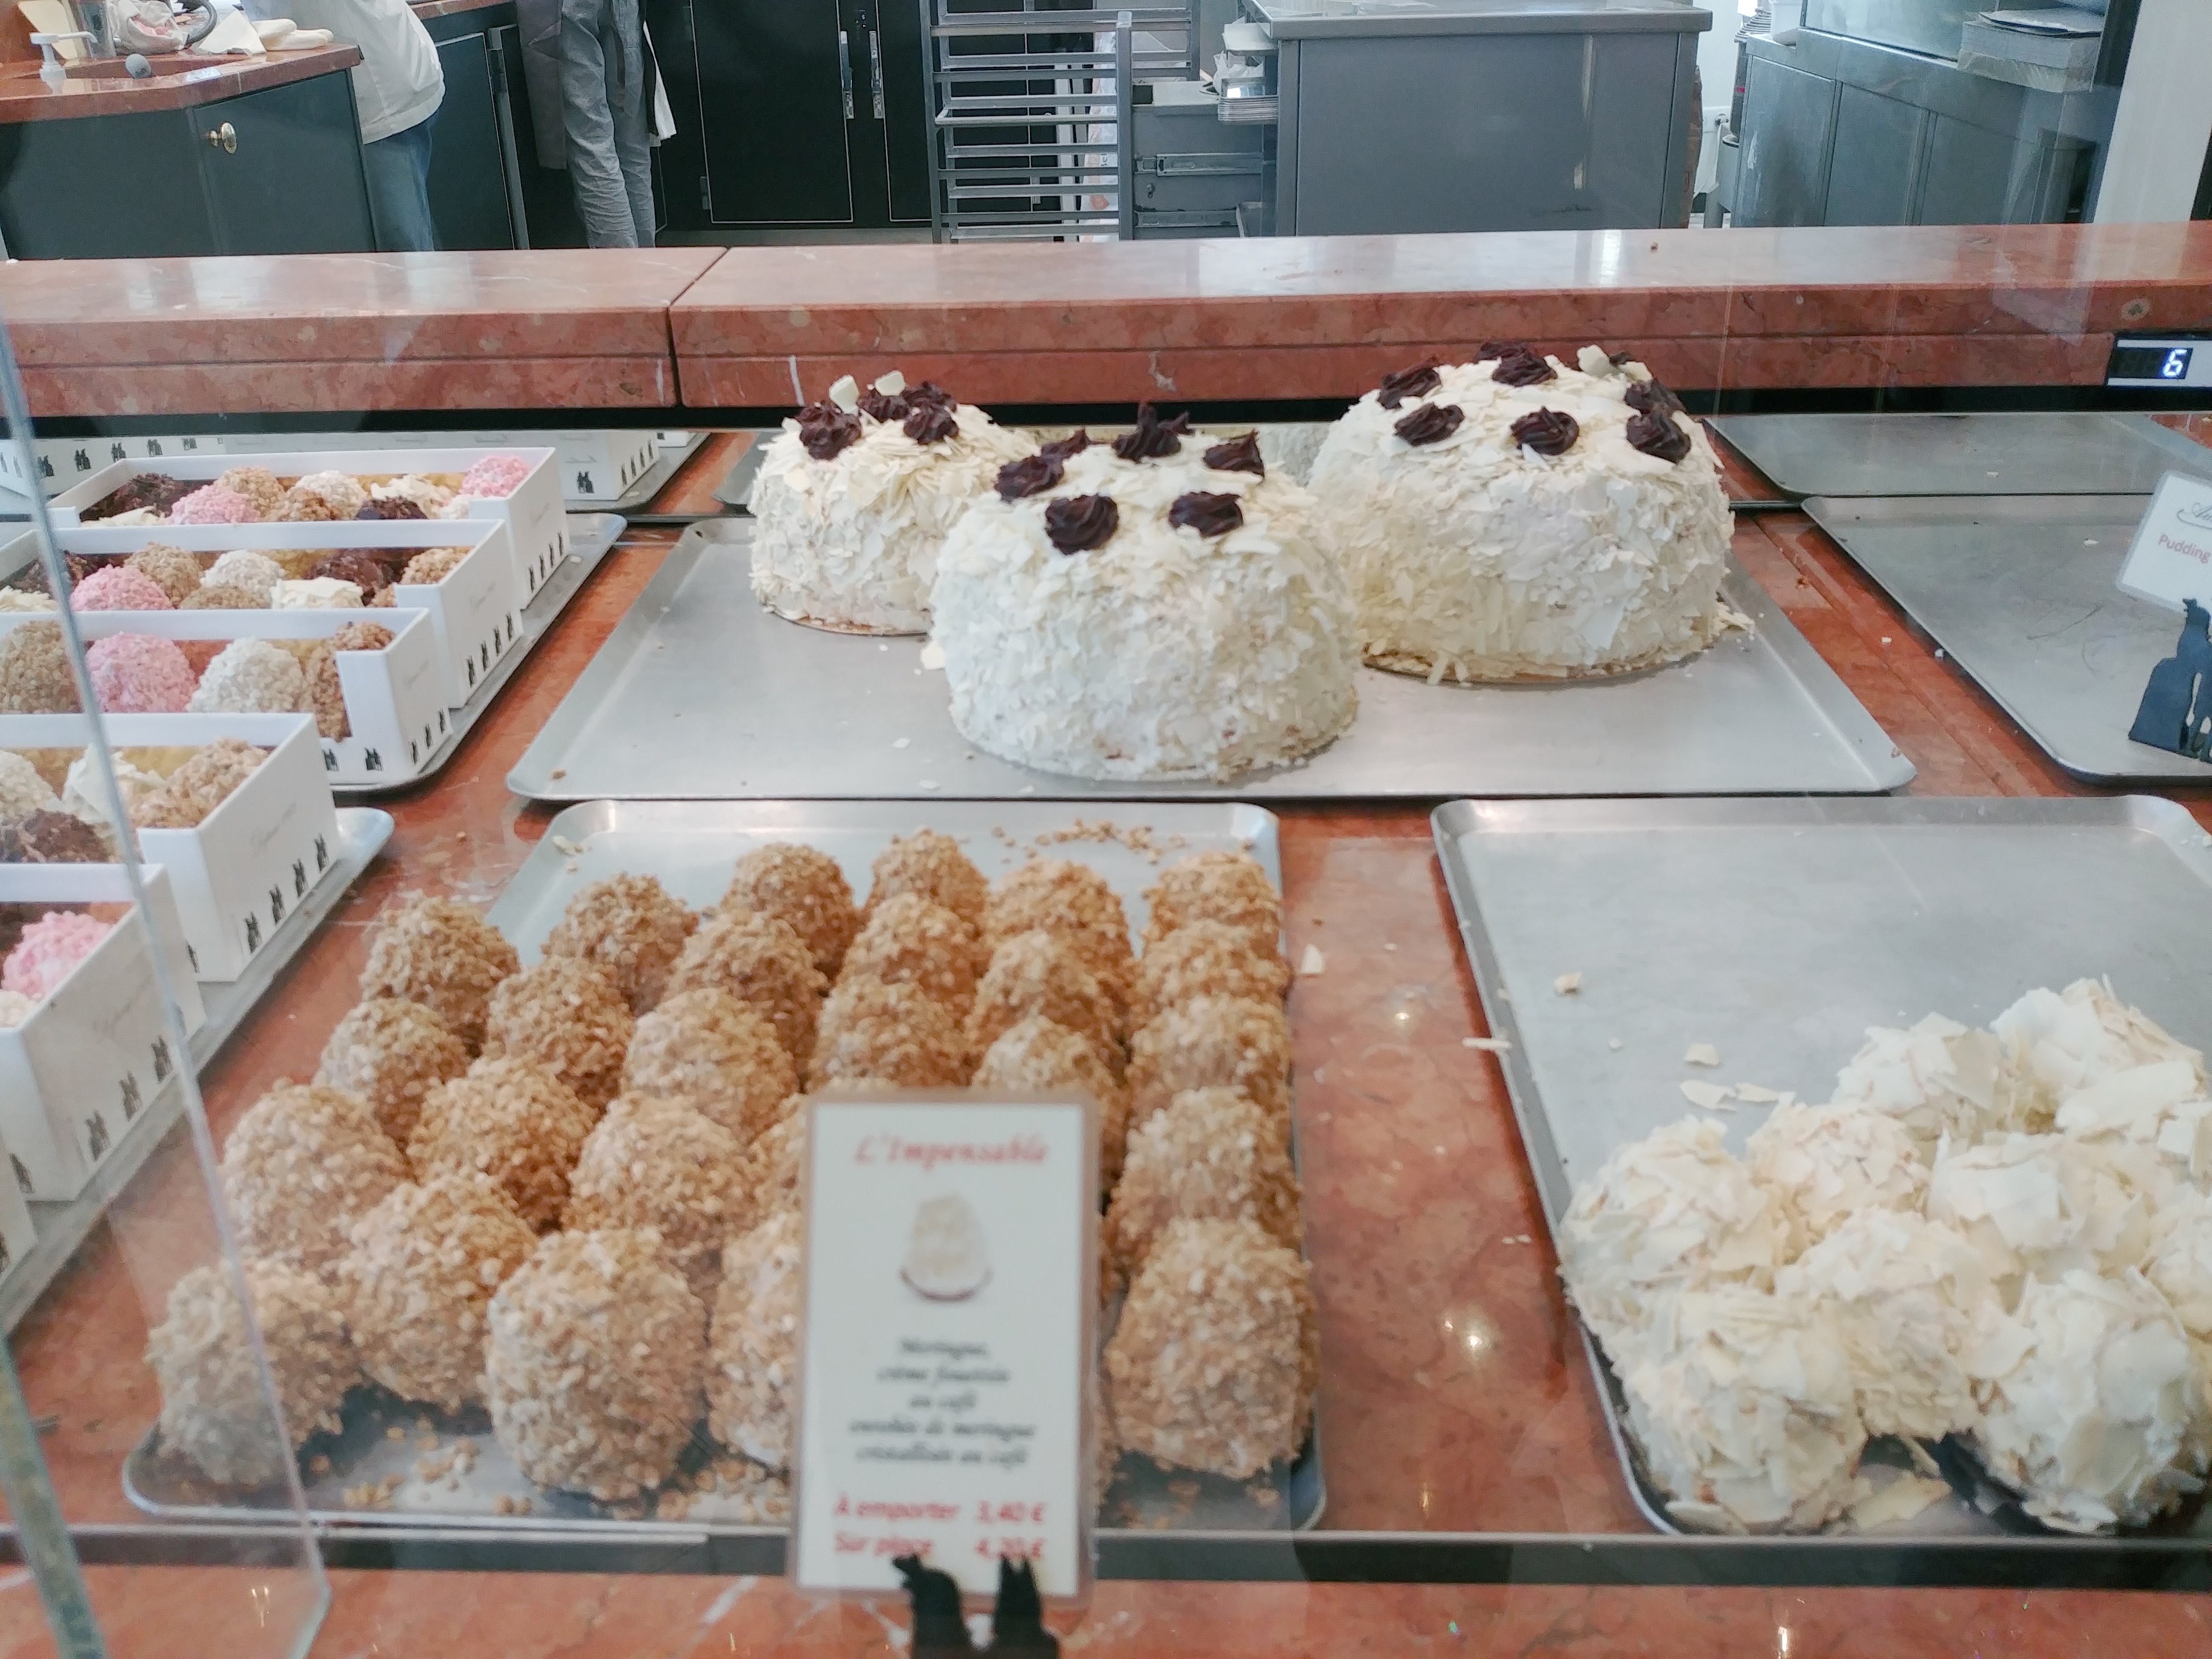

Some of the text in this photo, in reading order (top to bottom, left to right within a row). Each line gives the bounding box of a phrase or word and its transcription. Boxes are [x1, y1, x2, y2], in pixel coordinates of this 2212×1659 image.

[2163, 349, 2187, 377] 6
[2158, 533, 2212, 564] Pudding
[854, 1501, 960, 1522] emporter
